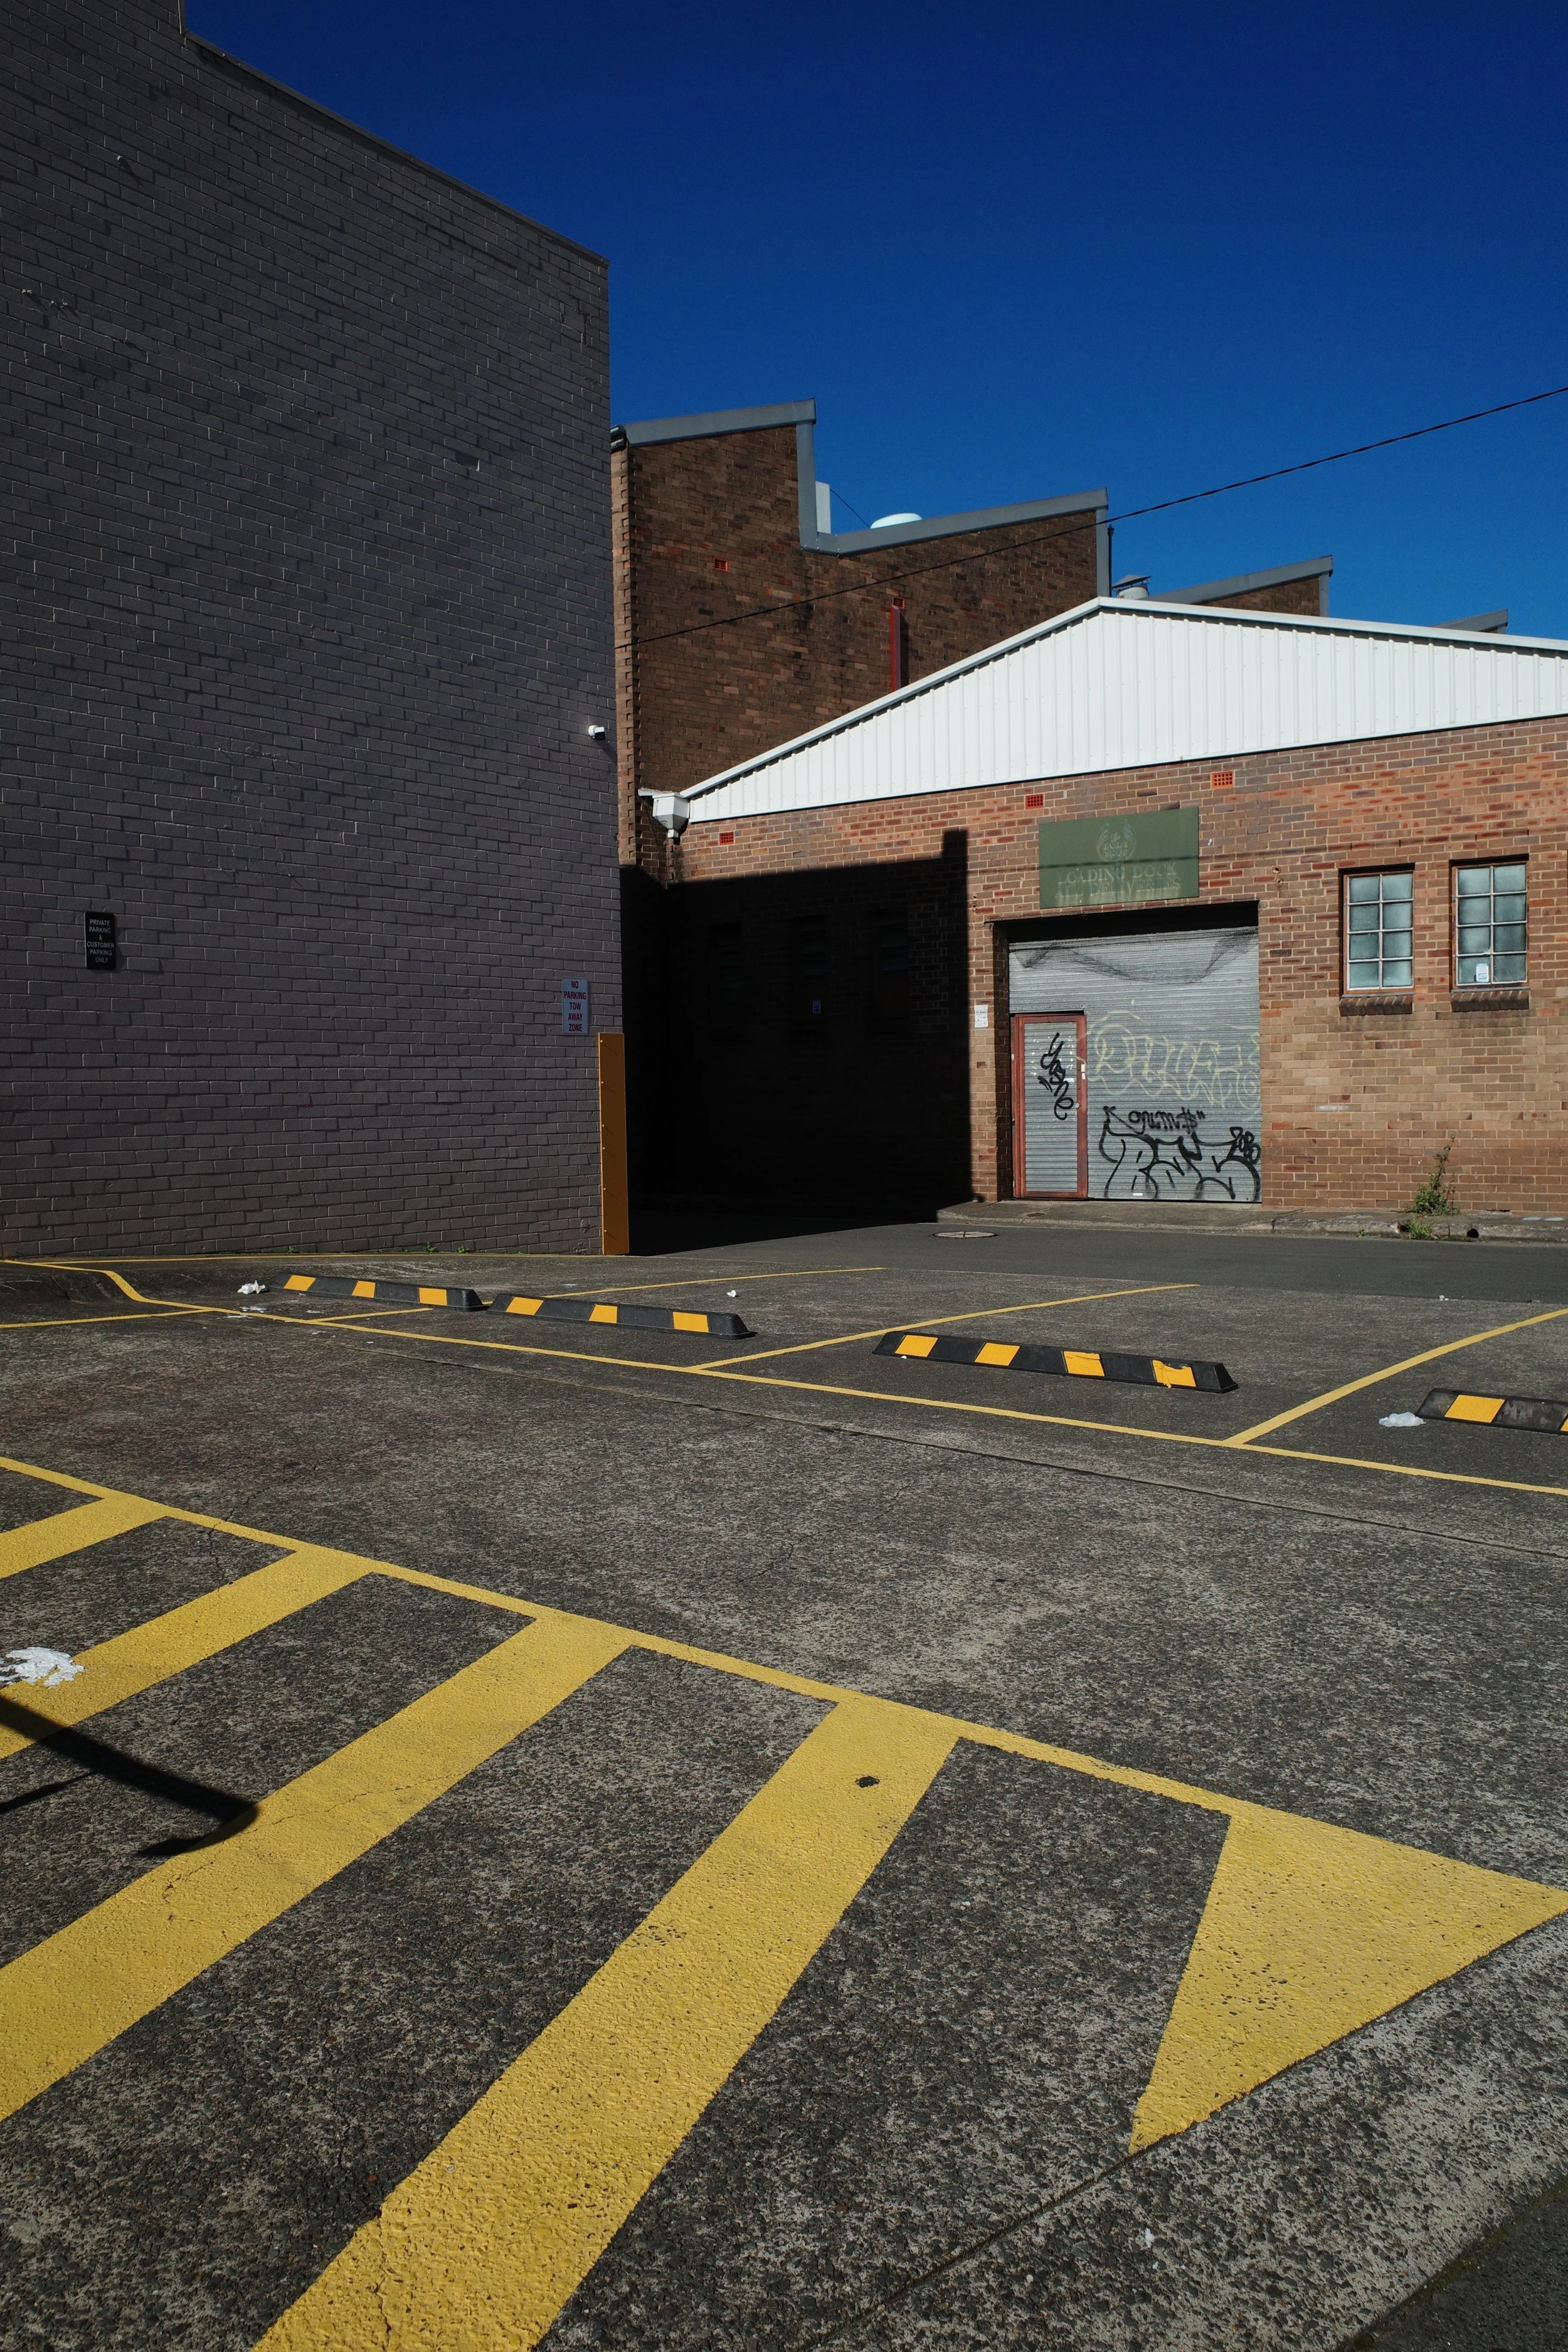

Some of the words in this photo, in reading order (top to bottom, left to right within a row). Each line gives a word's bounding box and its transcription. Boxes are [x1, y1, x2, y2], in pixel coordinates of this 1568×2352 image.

[1057, 866, 1125, 884] LOADING
[1132, 862, 1178, 879] DOCK
[571, 980, 579, 989] NO
[564, 991, 586, 1000] PARKING
[569, 1002, 581, 1010] TOW
[568, 1013, 583, 1021] AWAY
[569, 1023, 583, 1032] ZONE
